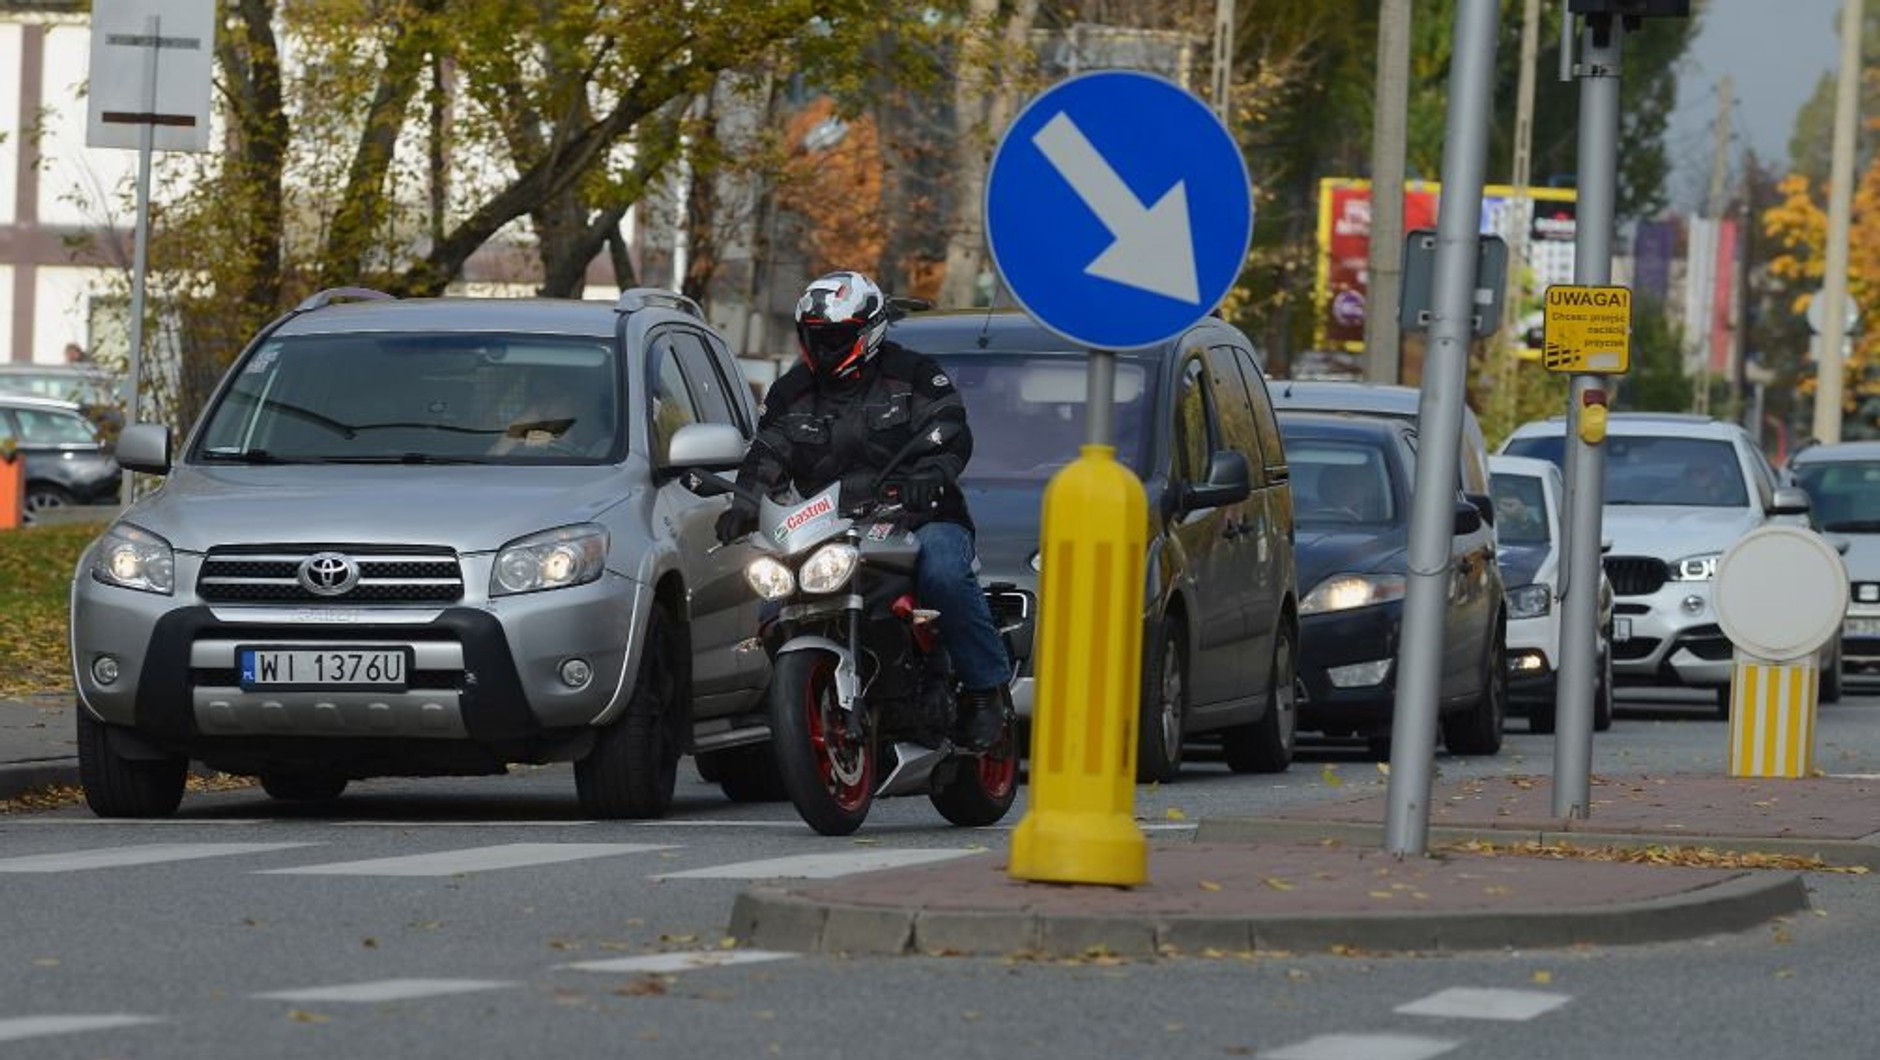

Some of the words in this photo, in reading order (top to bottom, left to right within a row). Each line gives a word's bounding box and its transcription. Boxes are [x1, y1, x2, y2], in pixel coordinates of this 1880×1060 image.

[1550, 292, 1627, 307] UWAGA!
[786, 497, 832, 530] Castrol
[260, 654, 294, 682] WI
[314, 654, 401, 682] 1376U
